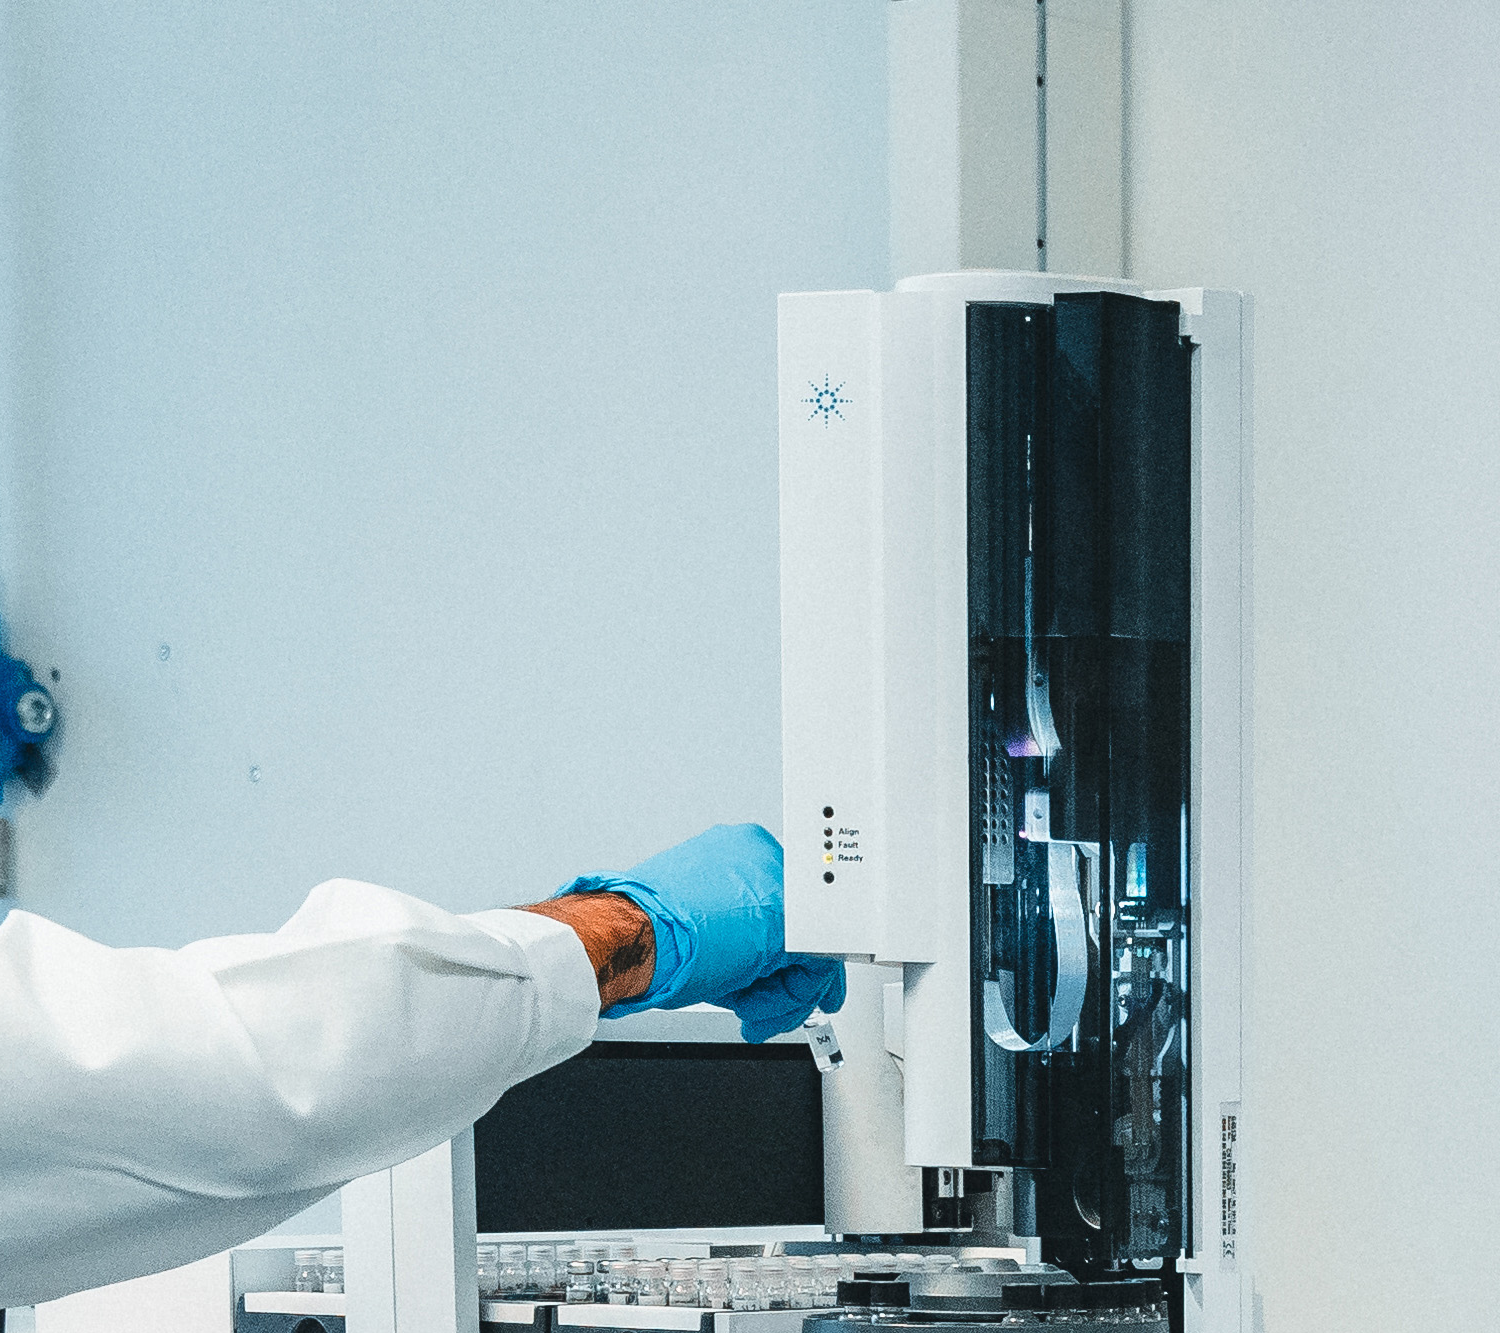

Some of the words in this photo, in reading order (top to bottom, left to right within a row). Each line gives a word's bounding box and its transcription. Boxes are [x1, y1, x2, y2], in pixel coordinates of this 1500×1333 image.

[838, 827, 860, 837] Align
[838, 840, 859, 849] Fault
[837, 853, 864, 863] Ready
